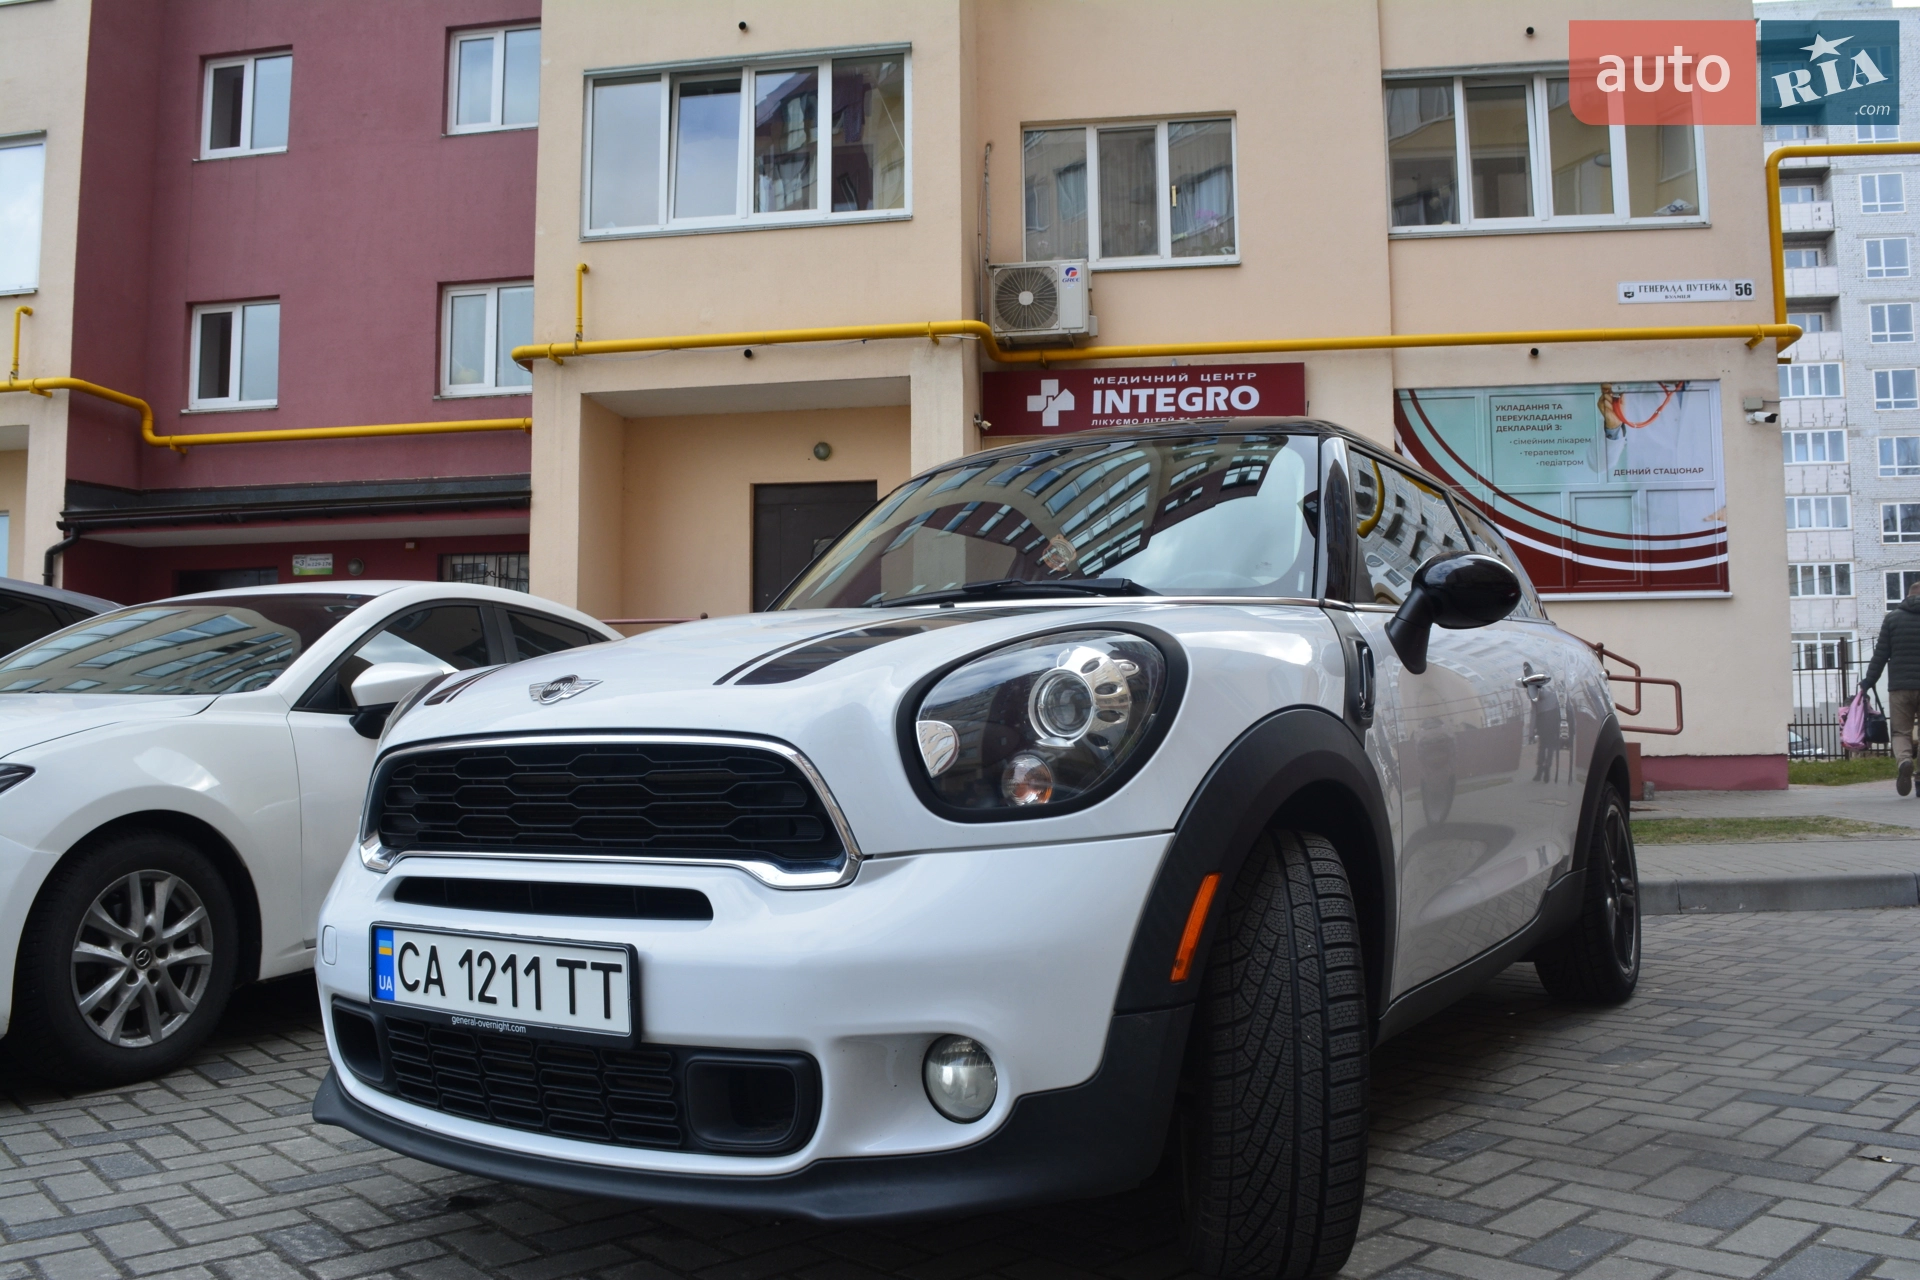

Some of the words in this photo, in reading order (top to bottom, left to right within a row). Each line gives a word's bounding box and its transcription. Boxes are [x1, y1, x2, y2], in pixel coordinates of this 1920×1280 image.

[1638, 284, 1683, 294] ГЕНЕРАЛА
[1686, 282, 1728, 292] ПУТЕЙКА
[1734, 282, 1753, 297] 56
[1093, 372, 1189, 385] МЕДИЧНИЙ
[1200, 371, 1258, 383] ЦЕНТР
[1092, 385, 1260, 415] INTEGRO
[1495, 403, 1550, 412] УКЛАДАННЯ
[1552, 403, 1563, 411] ТА
[1091, 418, 1139, 426] ЛІКУЄМО
[1495, 413, 1572, 423] ПЕРЕУКЛАДАННЯ
[1495, 423, 1553, 433] ДЕКЛАРАЦІЙ
[1513, 437, 1555, 446] сімейним
[1557, 436, 1592, 447] лікарем
[1524, 449, 1575, 458] терапевтом
[1539, 458, 1584, 468] педіатром
[1613, 467, 1651, 477] ДЕННИЙ
[1653, 467, 1704, 477] СТАЦІОНАР
[544, 682, 572, 692] MINI
[379, 975, 393, 991] UA
[398, 941, 446, 996] CA
[458, 948, 542, 1011] 1211
[556, 958, 622, 1019] TT
[451, 1014, 527, 1034] general-overnight.com
